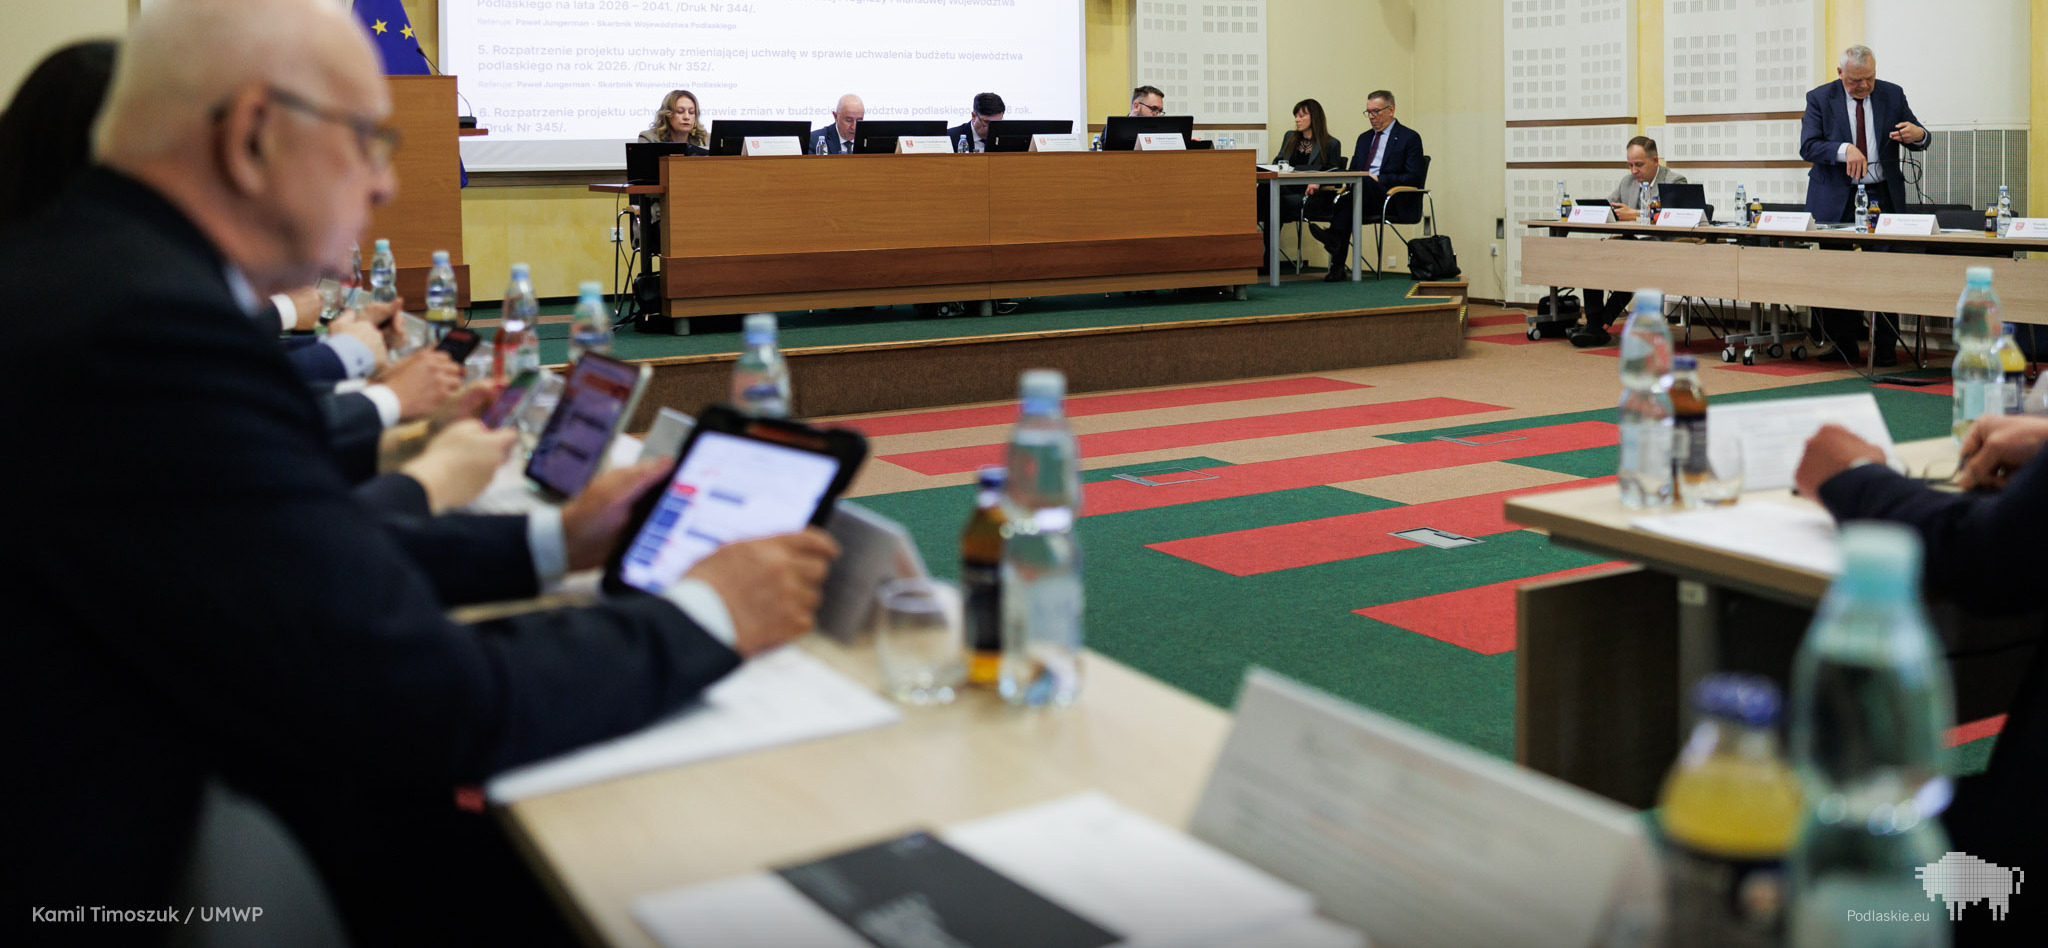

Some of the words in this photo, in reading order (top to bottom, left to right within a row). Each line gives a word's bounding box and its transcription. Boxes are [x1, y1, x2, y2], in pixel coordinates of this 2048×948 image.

[478, 0, 552, 10] Podlaskiego
[556, 2, 570, 10] na
[574, 0, 595, 10] lata
[599, 1, 629, 10] 2026
[642, 2, 672, 11] 2041.
[676, 3, 707, 13] /Druk
[710, 4, 724, 12] Nr
[727, 4, 756, 14] 344/.
[543, 19, 589, 28] Jungerman
[634, 20, 689, 29] Województwa
[691, 22, 736, 30] Podlaskiego
[478, 44, 489, 54] 5.
[493, 45, 573, 56] Rozpatrzenie
[576, 46, 624, 58] projektu
[628, 46, 676, 58] uchwały
[680, 47, 748, 60] zmieniającej
[752, 48, 796, 60] uchwałę
[812, 49, 852, 60] sprawie
[856, 50, 912, 59] uchwalenia
[916, 50, 956, 60] budżetu
[958, 50, 1023, 62] województwa
[478, 61, 552, 72] podlaskiego
[574, 61, 593, 71] rok
[597, 61, 630, 71] 2026.
[634, 61, 666, 72] /Druk
[669, 62, 682, 71] Nr
[686, 62, 715, 72] 352/.
[544, 81, 590, 90] Jungerman
[635, 81, 690, 90] Województwa
[692, 81, 738, 90] Podlaskiego
[479, 108, 490, 118] 6.
[494, 107, 574, 119] Rozpatrzenie
[578, 106, 625, 119] projektu
[700, 106, 737, 118] prawie
[740, 106, 772, 116] zmian
[776, 108, 784, 116] w
[912, 105, 970, 118] podlaskiego
[1014, 106, 1032, 115] rok.
[517, 122, 531, 132] Nr
[536, 122, 566, 134] 345/.
